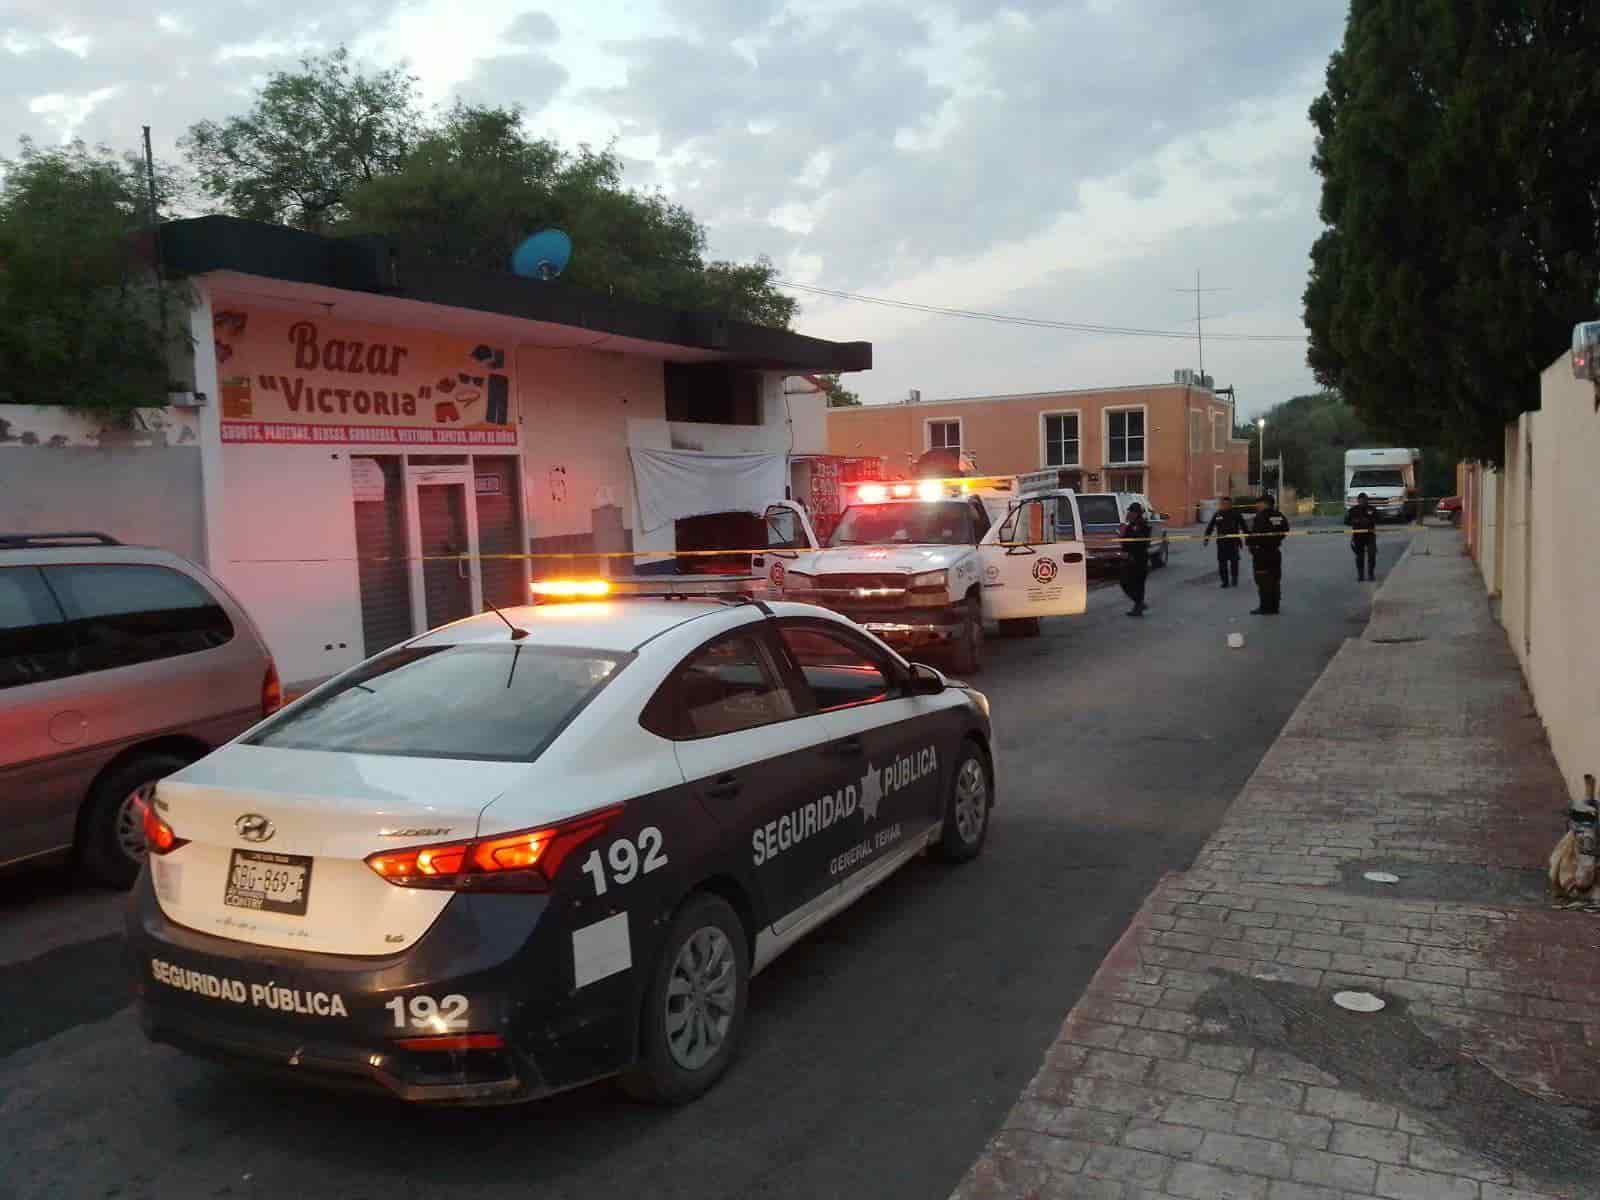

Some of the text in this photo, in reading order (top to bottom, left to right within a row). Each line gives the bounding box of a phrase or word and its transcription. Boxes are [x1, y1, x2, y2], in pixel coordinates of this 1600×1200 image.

[288, 321, 408, 377] Bazar
[752, 744, 938, 867] SEGURIDAD PÚBLICA
[582, 827, 669, 897] 192
[151, 958, 349, 1019] SEGURIDAD PÚBLICA
[385, 994, 471, 1030] 192
